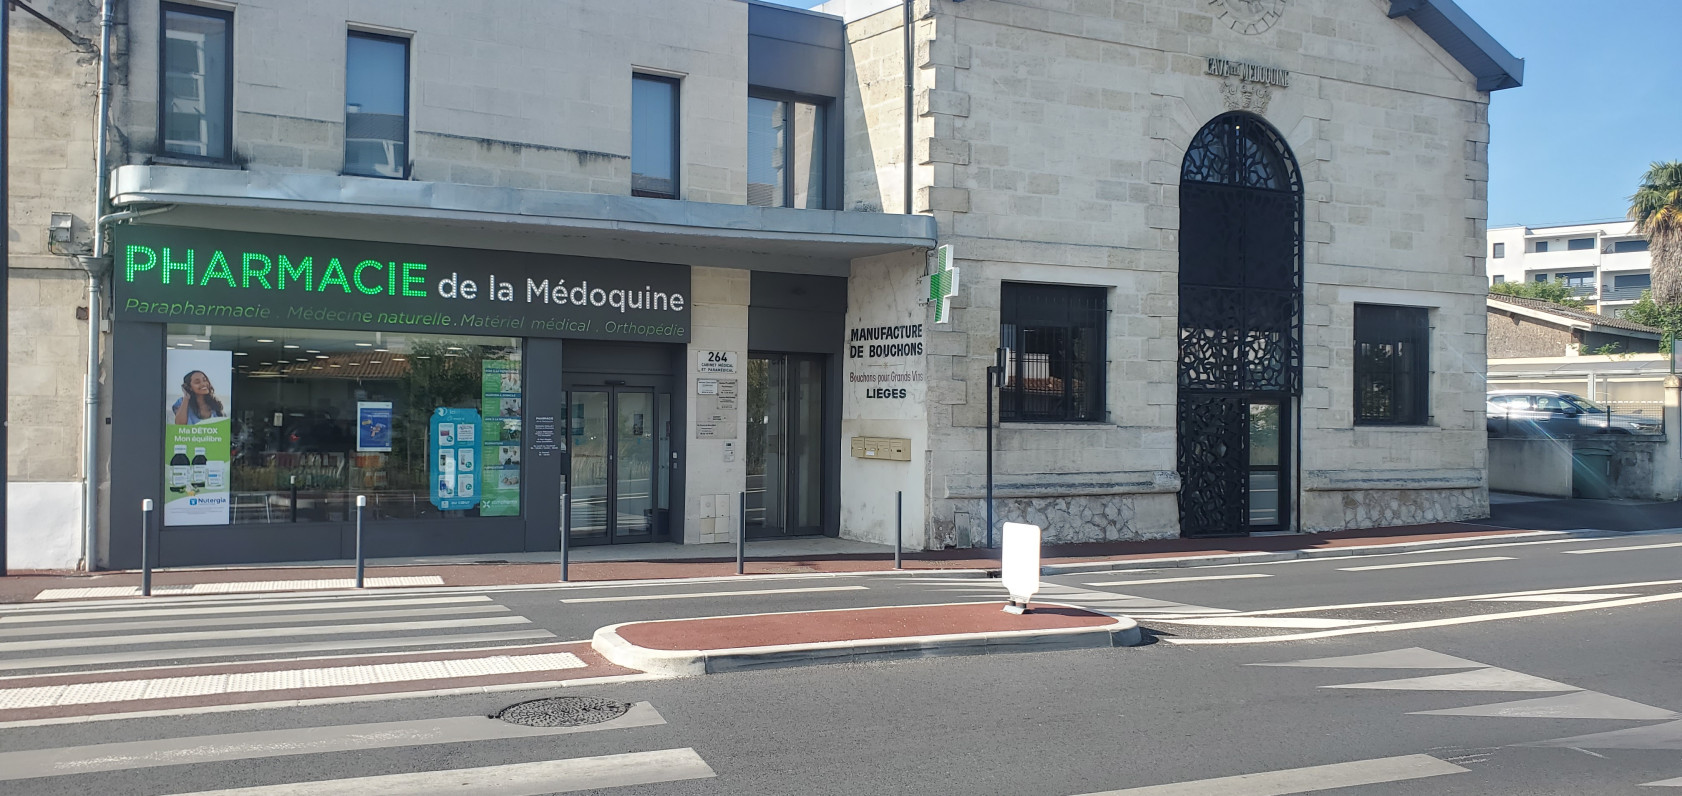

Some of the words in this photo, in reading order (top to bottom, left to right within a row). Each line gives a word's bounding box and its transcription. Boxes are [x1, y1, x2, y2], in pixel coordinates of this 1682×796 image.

[126, 244, 427, 297] PHARMACIE
[438, 272, 478, 300] de
[489, 274, 514, 302] la
[526, 278, 685, 313] Médoquine
[125, 298, 271, 319] Parapharmacie
[287, 306, 373, 323] Médecine
[377, 311, 452, 326] naturelle
[460, 313, 525, 329] Matériel
[531, 317, 591, 332] médical
[605, 320, 685, 337] Orthopédie
[851, 324, 922, 341] MANUFACTURE
[708, 351, 727, 362] 264
[850, 345, 864, 358] DE
[869, 342, 923, 358] BOUCHONS
[850, 372, 876, 383] Bouchons
[878, 374, 890, 385] pour
[891, 371, 911, 381] Grands
[191, 435, 222, 443] équilibre
[198, 496, 226, 504] Nutergia
